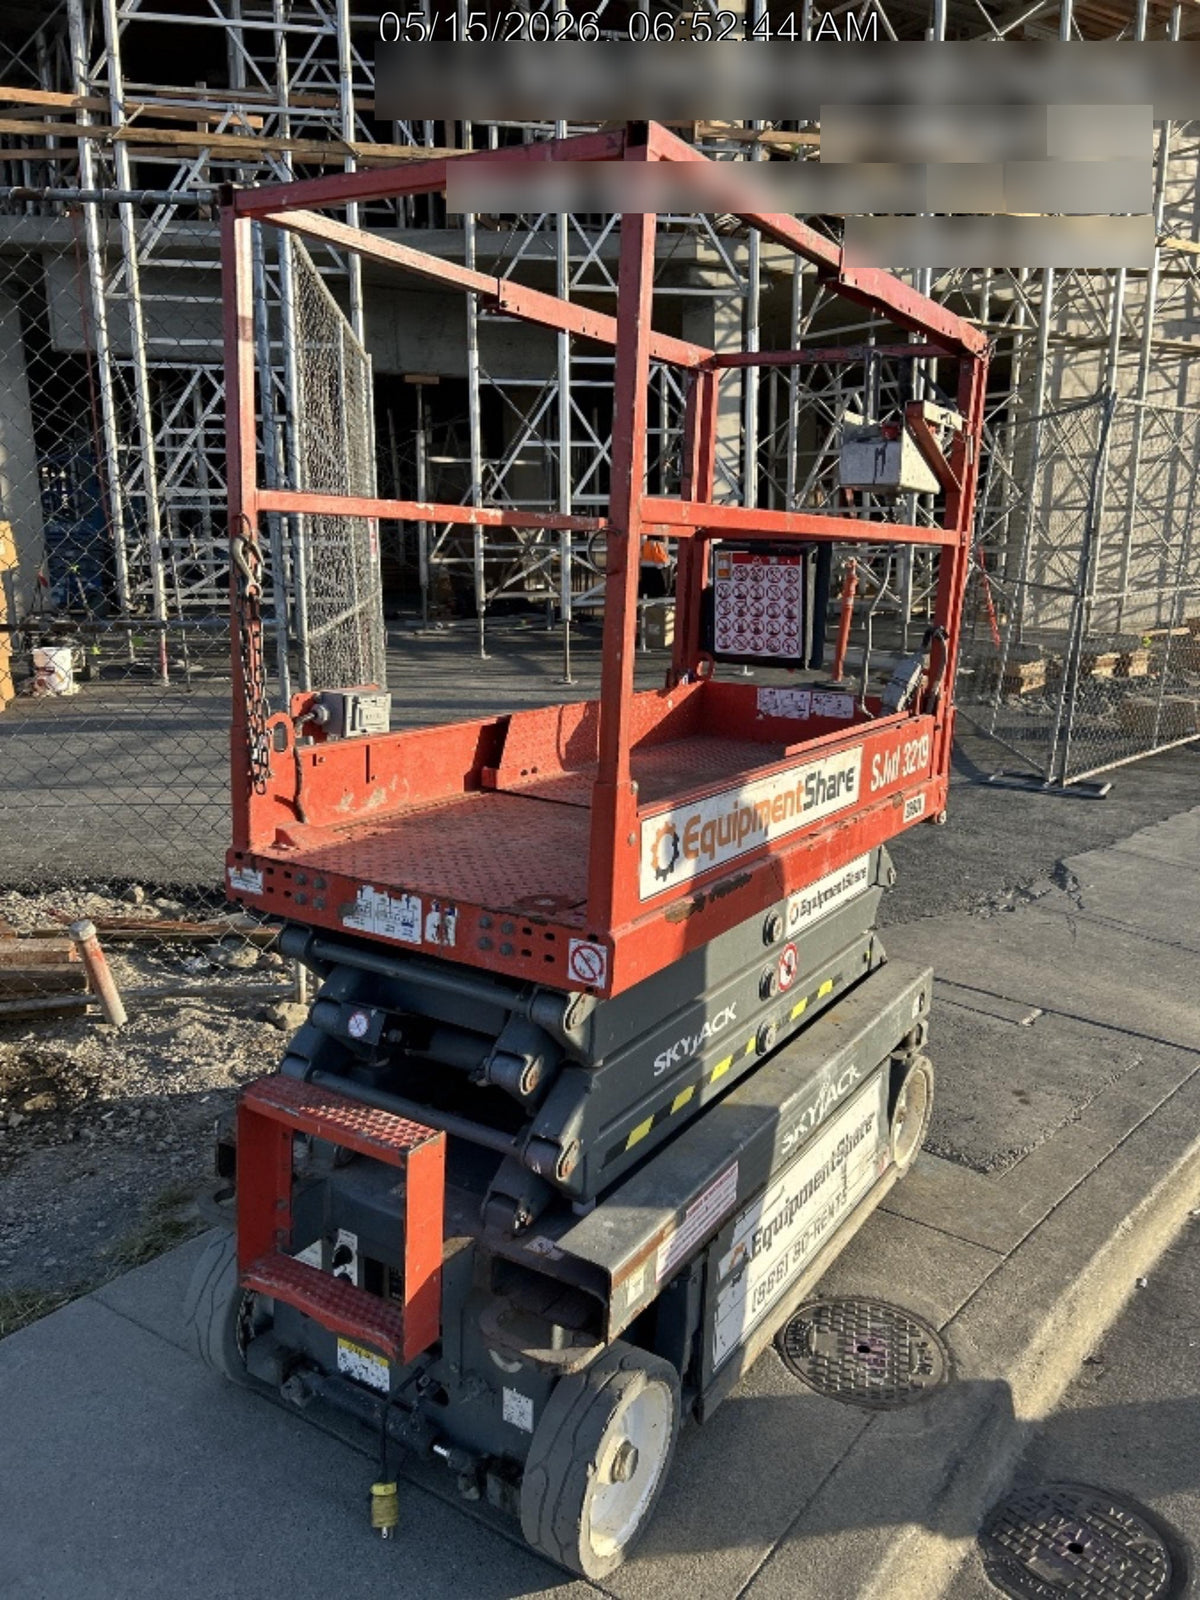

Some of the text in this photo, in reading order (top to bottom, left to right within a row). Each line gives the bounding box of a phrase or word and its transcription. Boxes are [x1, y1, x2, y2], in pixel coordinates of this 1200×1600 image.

[902, 734, 929, 777] 3219
[682, 765, 855, 861] EquipmentShare
[653, 1002, 737, 1076] SKYJACK
[751, 1111, 876, 1262] EquipmentShare
